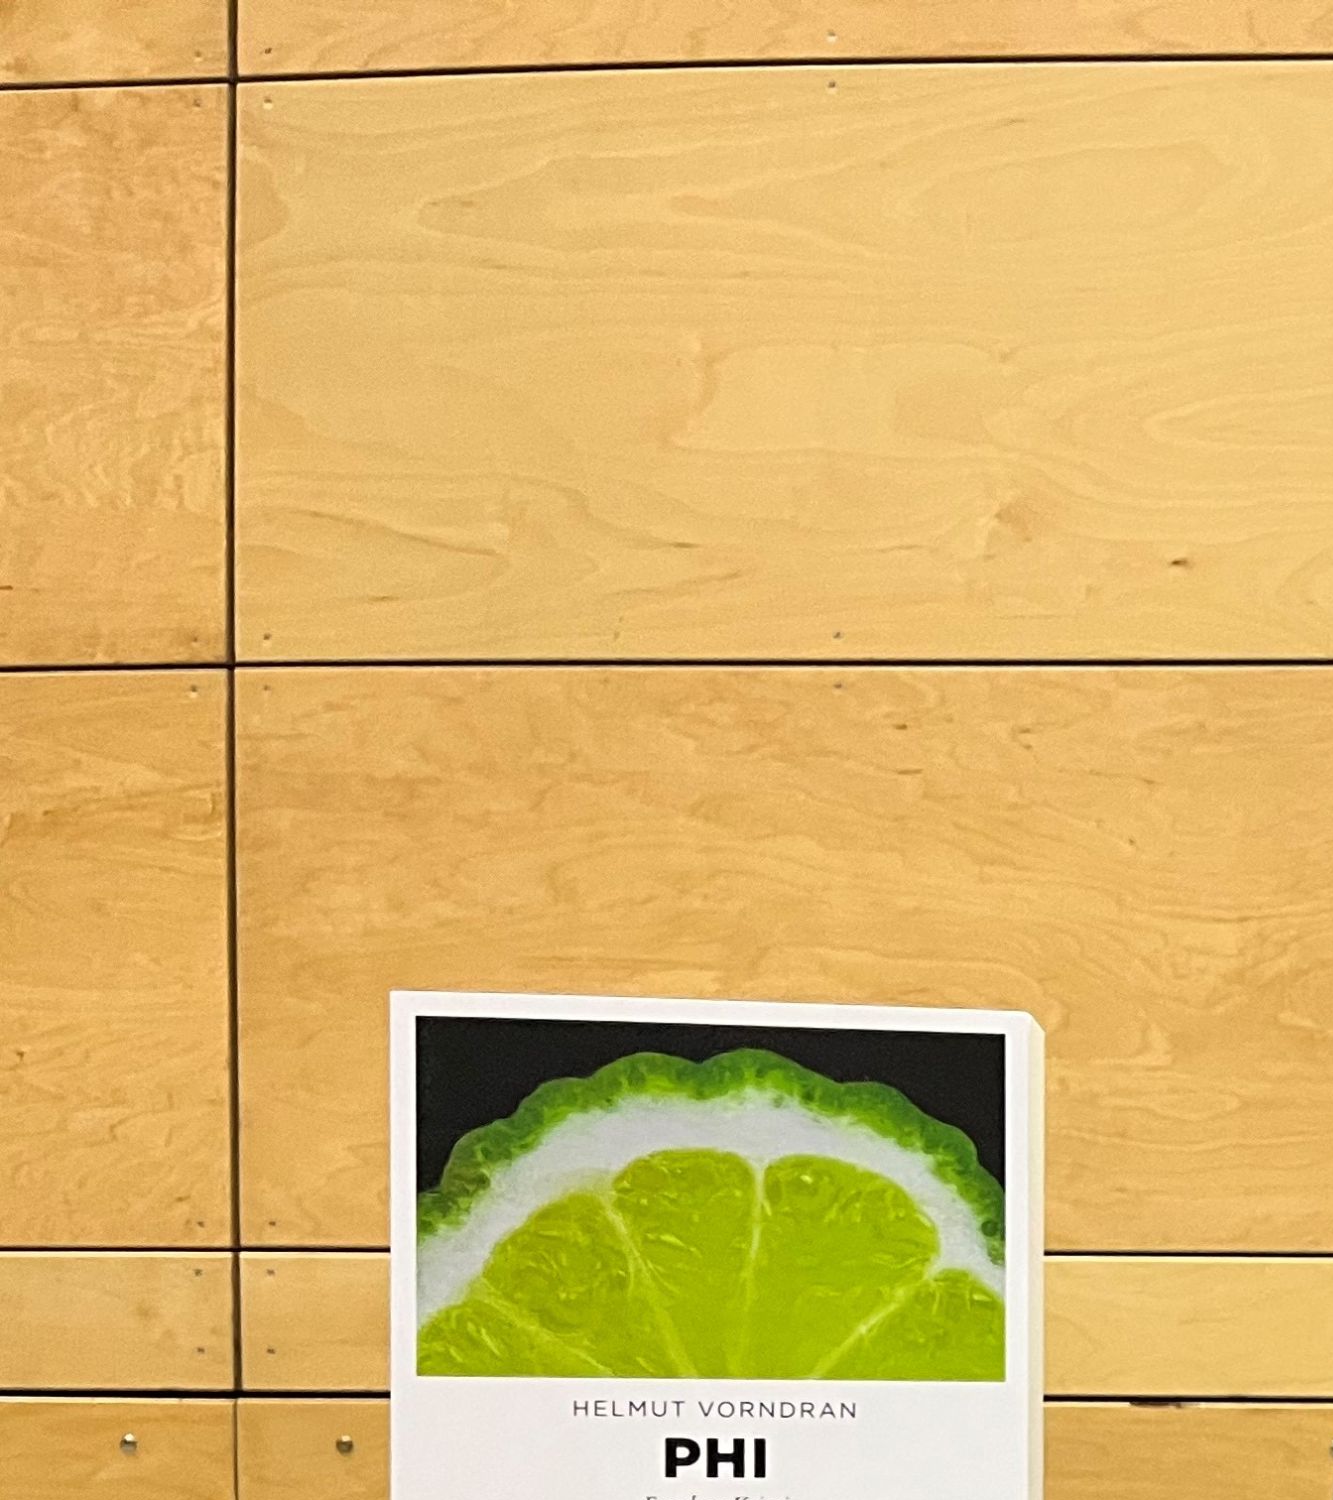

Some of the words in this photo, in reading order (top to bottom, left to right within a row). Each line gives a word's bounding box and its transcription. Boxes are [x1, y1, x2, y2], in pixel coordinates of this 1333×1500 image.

[572, 1400, 684, 1418] HELMUT
[699, 1400, 857, 1419] VORNDRAN
[665, 1438, 766, 1478] PHI
